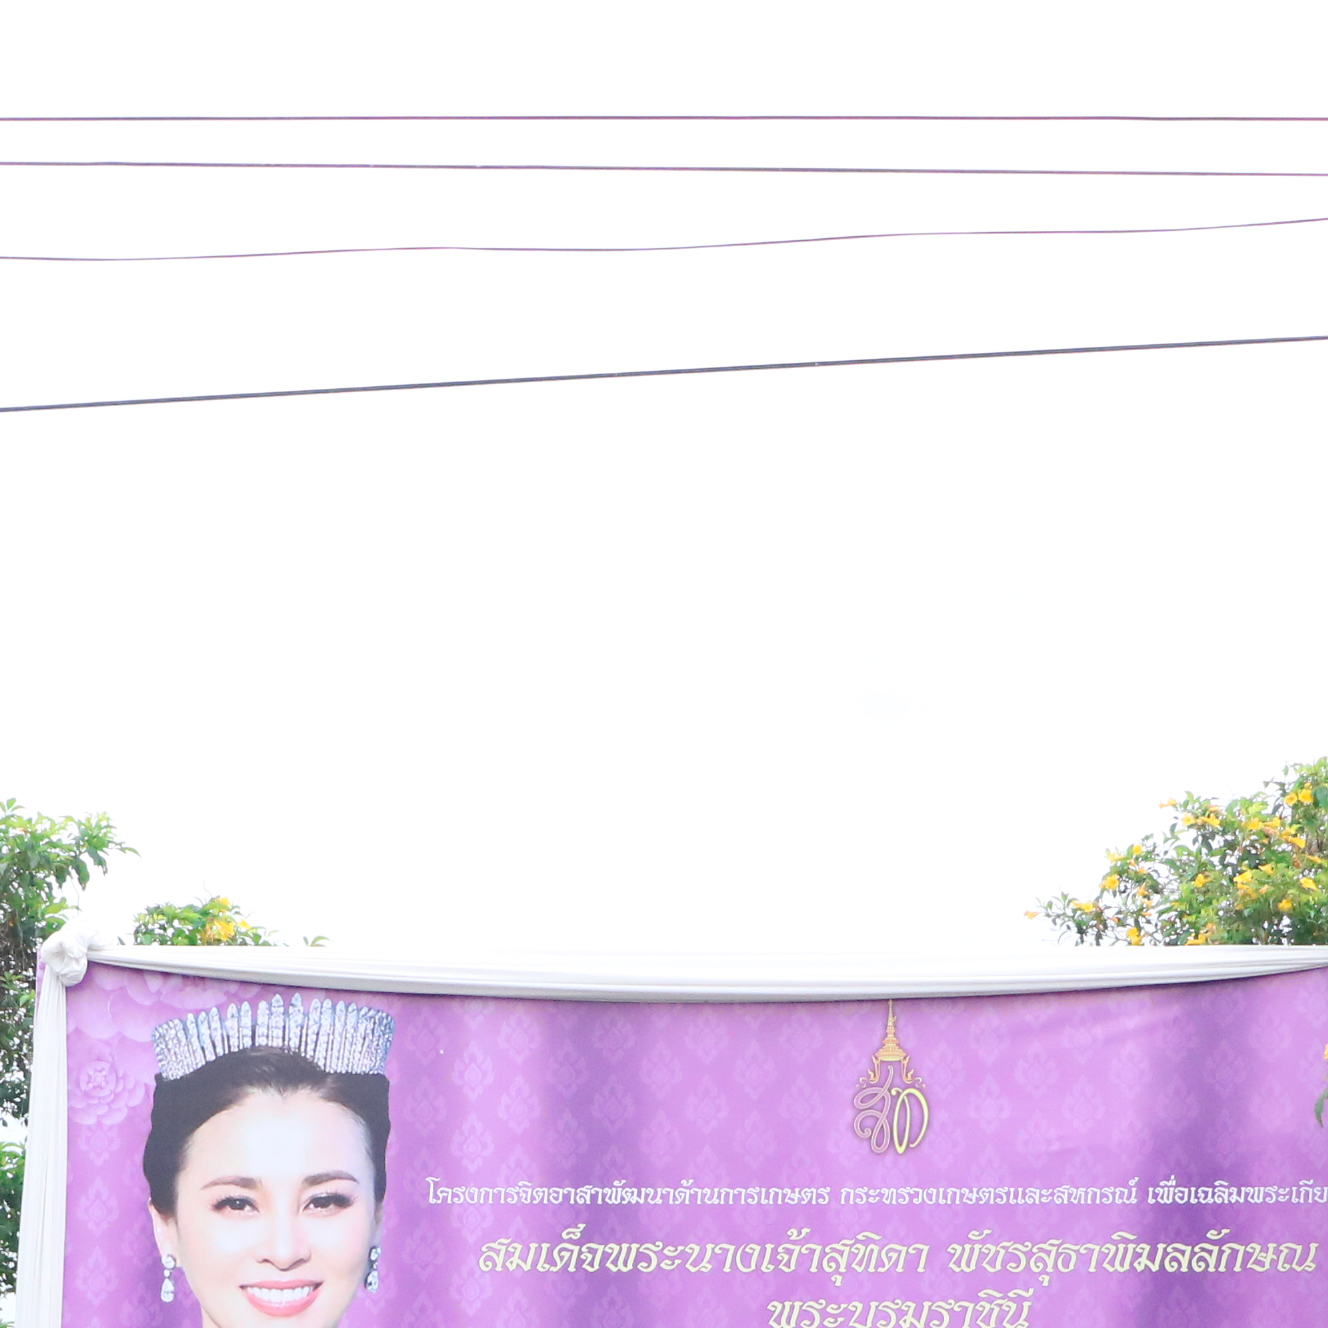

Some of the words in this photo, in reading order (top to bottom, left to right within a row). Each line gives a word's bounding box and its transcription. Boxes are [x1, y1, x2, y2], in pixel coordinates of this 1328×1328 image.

[425, 1176, 831, 1206] โครงการจิตอาสาพัฒนาด้านการเกษตร
[839, 1176, 1138, 1206] กระทรวงเกษตรและสหกรณ์
[477, 1223, 930, 1287] สมเด็จพระนางเจ้าสุทิดา
[946, 1228, 1319, 1287] พัชรสุธาพิมลลักษณ
